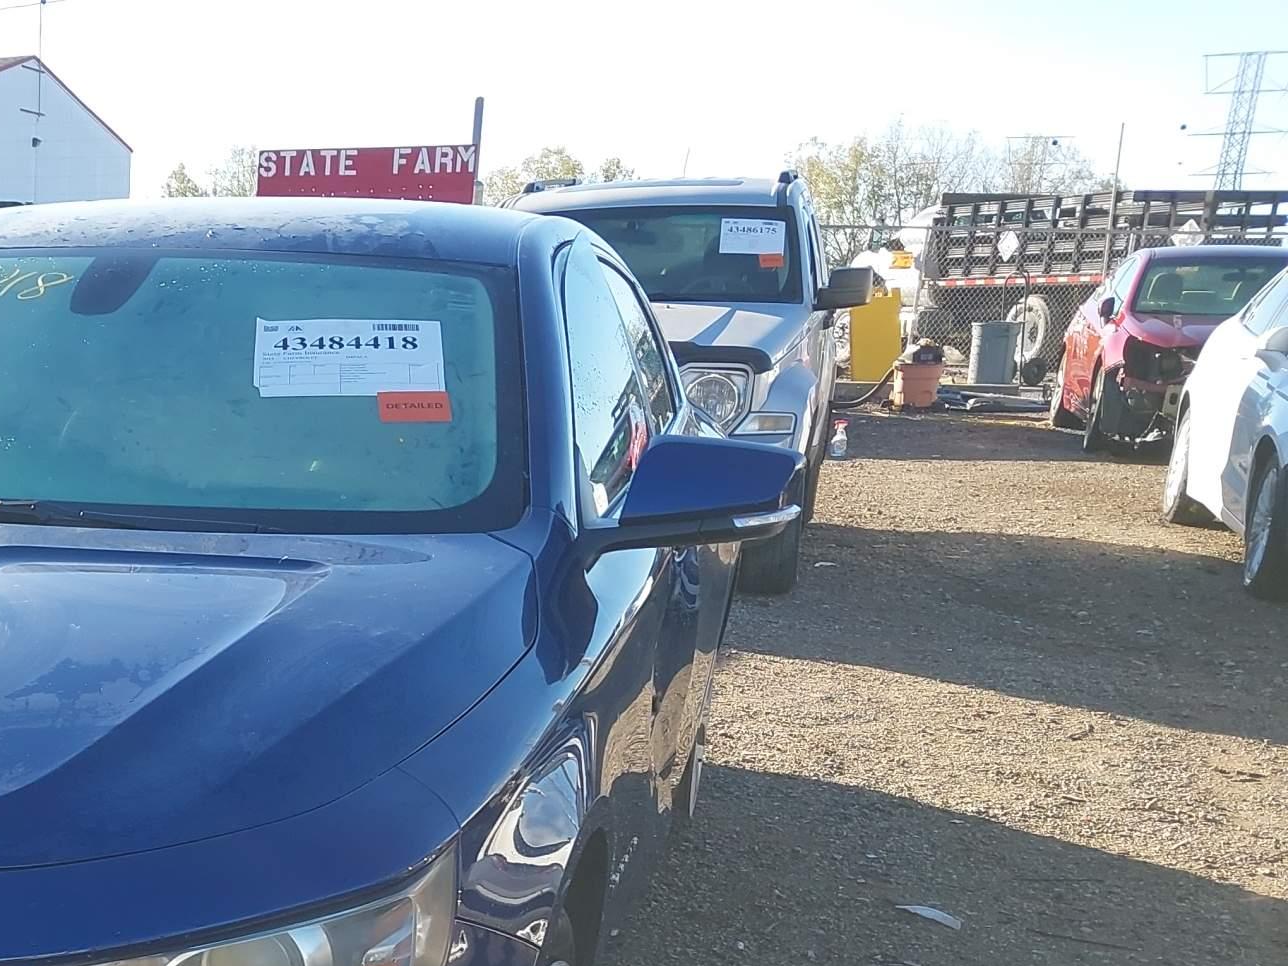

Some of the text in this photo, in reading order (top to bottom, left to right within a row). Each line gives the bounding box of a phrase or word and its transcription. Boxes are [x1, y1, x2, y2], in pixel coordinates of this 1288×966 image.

[259, 146, 476, 178] STATE FARM
[727, 226, 777, 235] 43486175
[274, 335, 419, 351] 43484418
[385, 402, 444, 410] DETAILED
